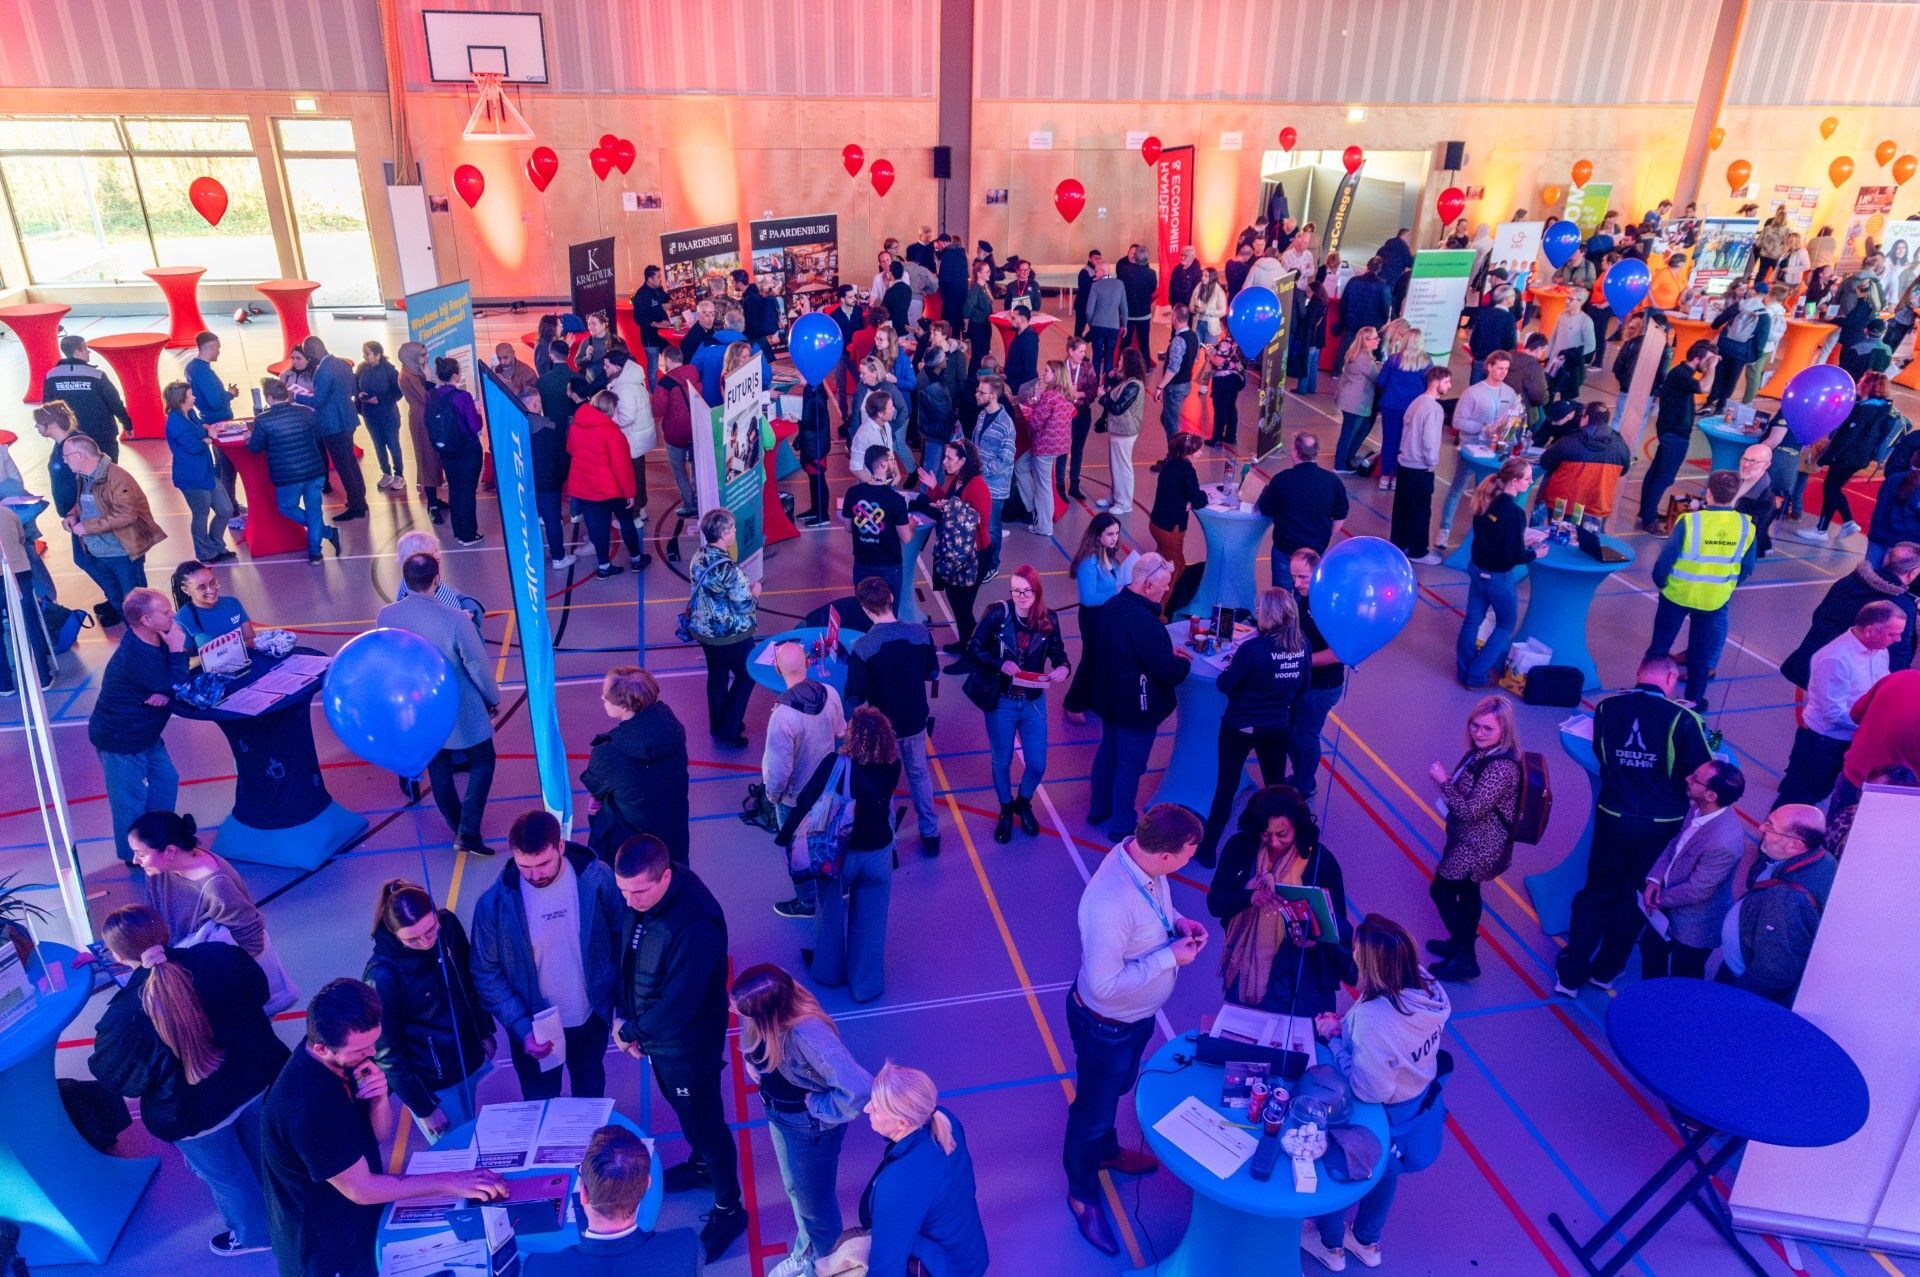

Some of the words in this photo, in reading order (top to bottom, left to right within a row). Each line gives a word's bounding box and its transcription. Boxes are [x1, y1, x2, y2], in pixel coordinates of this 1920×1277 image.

[1329, 186, 1352, 252] rsCollege
[769, 224, 830, 239] PAARDENBURG
[678, 233, 733, 251] PAARDENBURG
[588, 248, 599, 272] K
[1280, 661, 1299, 670] staat
[1616, 750, 1658, 761] DEUTZ
[1620, 758, 1654, 768] FAHR
